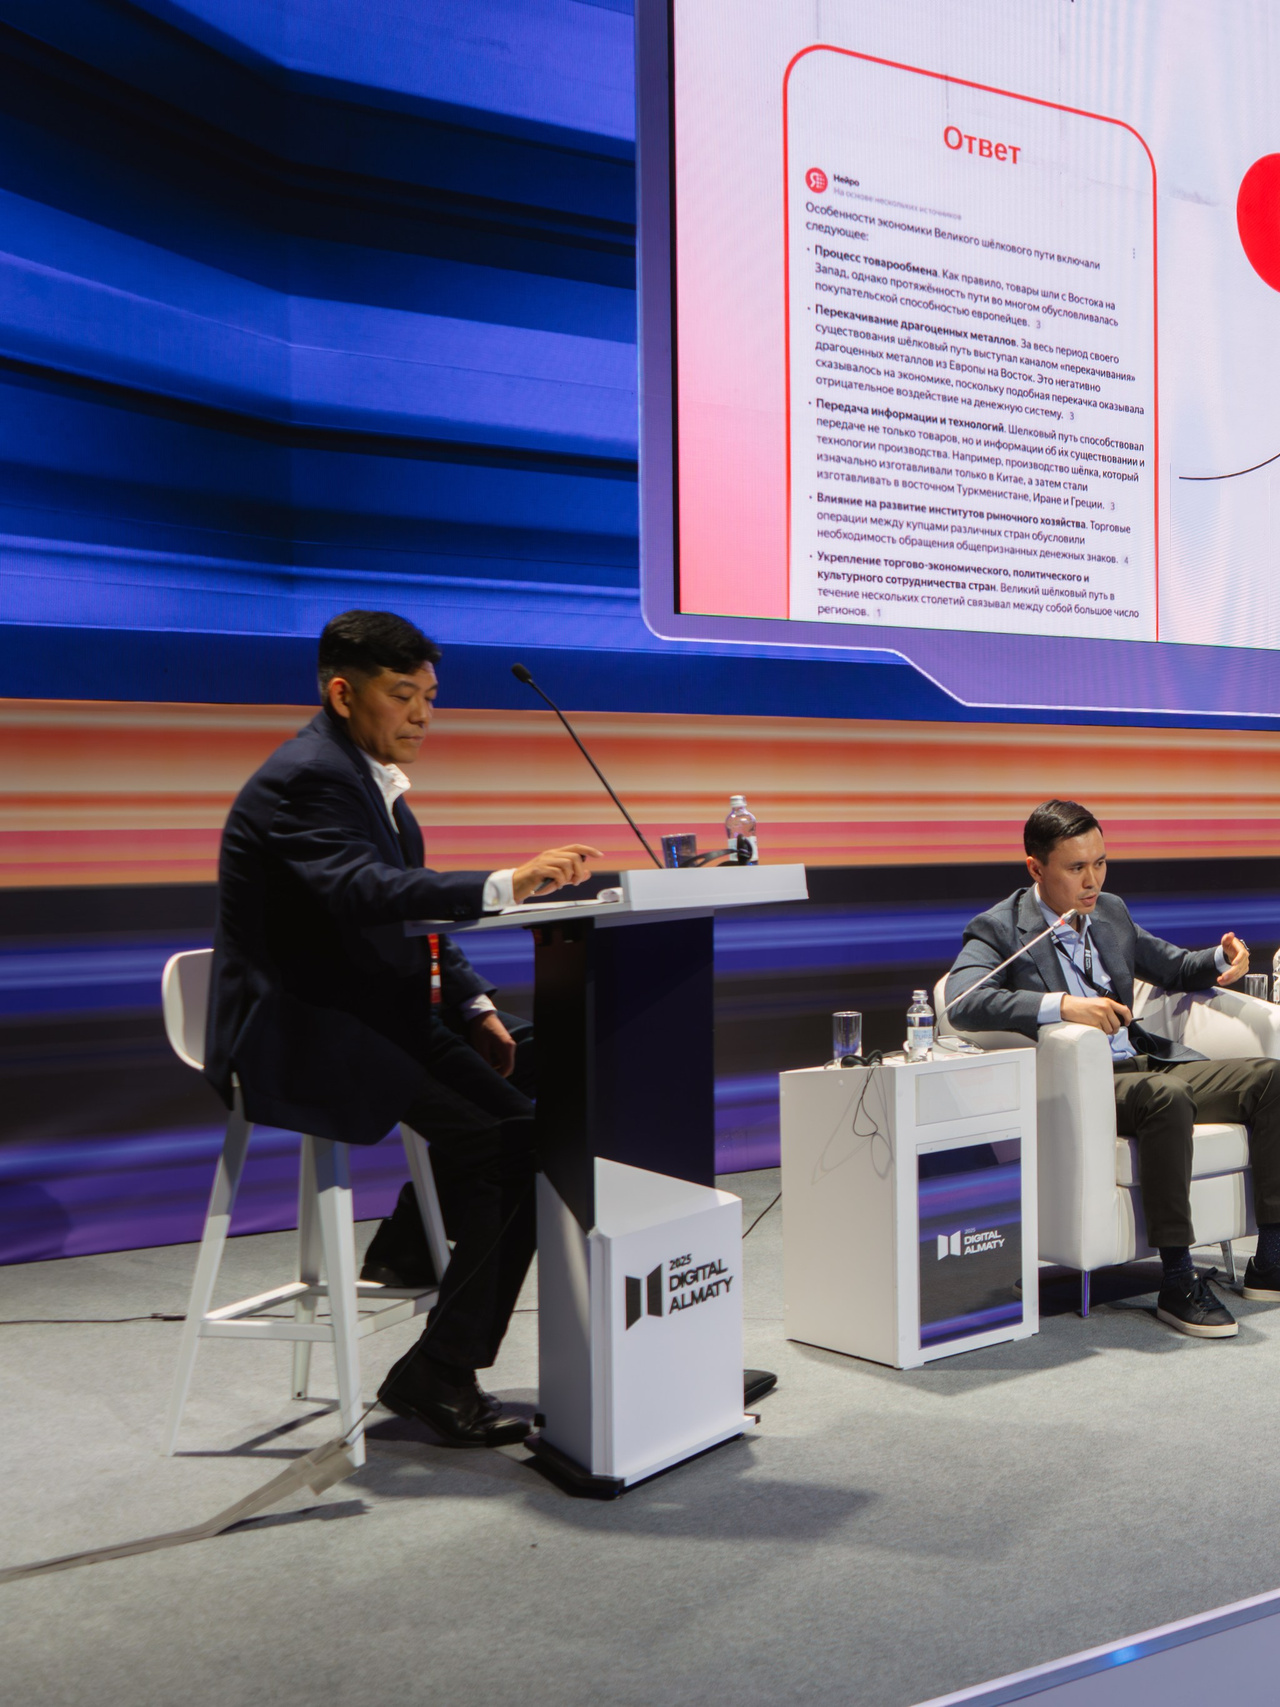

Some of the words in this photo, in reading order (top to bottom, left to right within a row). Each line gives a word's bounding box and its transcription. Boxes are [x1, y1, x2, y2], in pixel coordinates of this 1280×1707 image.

[944, 125, 1021, 165] Ответ
[833, 174, 860, 187] Нейро
[806, 222, 869, 240] следующее:
[806, 202, 876, 224] Особенности
[878, 218, 932, 236] экономики
[935, 227, 980, 245] Великого
[982, 239, 1032, 256] шёлкового
[1034, 250, 1055, 261] пути
[1057, 255, 1100, 269] включали
[815, 245, 861, 263] Процесс
[863, 256, 940, 277] товарообмена.
[942, 269, 959, 281] Как
[962, 275, 1004, 290] правило,
[1006, 283, 1039, 296] товары
[1041, 290, 1059, 299] шли
[1061, 293, 1066, 301] с
[1068, 293, 1103, 308] Востока
[1106, 302, 1115, 310] на
[815, 262, 849, 279] Запад,
[851, 272, 888, 285] однако
[890, 279, 966, 298] протяжённость
[968, 292, 989, 303] пути
[992, 297, 1003, 306] во
[1005, 299, 1040, 312] многом
[1042, 305, 1118, 326] обусловливалась
[815, 282, 898, 303] покупательской
[900, 298, 970, 316] способностью
[972, 310, 1030, 326] европейцев.
[815, 324, 895, 343] существования
[898, 337, 948, 351] шёлковый
[950, 345, 972, 356] путь
[974, 349, 1018, 363] выступал
[1020, 357, 1058, 369] каналом
[1060, 364, 1136, 381] «перекачивания»
[816, 304, 899, 327] Перекачивание
[900, 321, 968, 338] драгоценных
[970, 333, 1018, 347] металлов.
[1021, 338, 1032, 349] За
[1034, 343, 1054, 353] весь
[1056, 347, 1089, 360] период
[1090, 352, 1119, 364] своего
[815, 341, 884, 358] драгоценных
[886, 352, 934, 366] металлов
[936, 360, 947, 369] из
[950, 360, 986, 374] Европы
[988, 368, 999, 377] на
[1001, 368, 1035, 382] Восток.
[1037, 374, 1054, 385] Это
[1055, 379, 1101, 392] негативно
[816, 359, 882, 375] сказывалось
[884, 369, 895, 378] на
[898, 371, 953, 387] экономике,
[956, 380, 1004, 395] поскольку
[1006, 388, 1050, 400] подобная
[1052, 394, 1097, 407] перекачка
[1099, 401, 1144, 414] оказывала
[816, 377, 894, 395] отрицательное
[896, 388, 959, 403] воздействие
[961, 398, 972, 406] на
[974, 399, 1023, 413] денежную
[1025, 407, 1063, 420] систему.
[816, 398, 869, 414] Передача
[871, 408, 938, 424] информации
[940, 417, 946, 425] и
[948, 418, 1006, 432] технологий.
[1008, 425, 1056, 439] Шелковый
[1059, 433, 1078, 442] путь
[1080, 436, 1144, 451] способствовал
[817, 436, 876, 449] технологии
[879, 443, 950, 458] производства.
[953, 451, 1003, 466] Например,
[1006, 459, 1070, 473] производство
[1072, 465, 1101, 478] шёлка,
[1103, 471, 1139, 482] который
[817, 454, 877, 467] изначально
[879, 461, 952, 475] изготавливали
[955, 469, 987, 480] только
[989, 473, 994, 481] в
[997, 472, 1026, 485] Китае,
[1028, 478, 1033, 486] а
[1035, 479, 1061, 488] затем
[1063, 482, 1088, 491] стали
[817, 471, 892, 486] изготавливать
[894, 479, 899, 487] в
[902, 480, 955, 492] восточном
[957, 484, 1031, 502] Туркменистане,
[1033, 493, 1062, 505] Иране
[1071, 496, 1104, 509] Греции.
[817, 492, 863, 506] Влияние
[865, 499, 877, 508] на
[879, 501, 927, 513] развитие
[929, 506, 985, 519] институтов
[986, 512, 1039, 524] рыночного
[1040, 517, 1088, 529] хозяйства.
[1090, 520, 1131, 533] Торговые
[817, 529, 897, 544] необходимость
[899, 535, 954, 548] обращения
[956, 541, 1038, 556] общепризнанных
[1039, 550, 1085, 560] денежных
[1087, 554, 1118, 563] знаков.
[817, 551, 882, 566] Укрепление
[884, 559, 1011, 576] торгово-экономического,
[1013, 570, 1082, 582] политического
[1084, 575, 1090, 583] и
[818, 571, 883, 583] культурного
[885, 576, 966, 589] сотрудничества
[969, 583, 998, 592] стран.
[1001, 583, 1039, 594] Великий
[1042, 587, 1087, 598] шёлковый
[1089, 591, 1108, 600] путь
[1110, 593, 1115, 601] в
[818, 588, 859, 599] течение
[862, 592, 919, 602] нескольких
[921, 596, 965, 605] столетий
[967, 599, 1011, 609] связывал
[1013, 602, 1044, 613] между
[1046, 603, 1072, 613] собой
[1074, 604, 1112, 616] большое
[1114, 610, 1139, 618] число
[818, 606, 869, 616] регионов.
[964, 1230, 1002, 1245] DIGITAL
[964, 1238, 1006, 1256] ALMATY
[669, 1253, 692, 1271] 2025
[669, 1258, 729, 1292] DIGITAL
[668, 1276, 734, 1315] ALMATY
